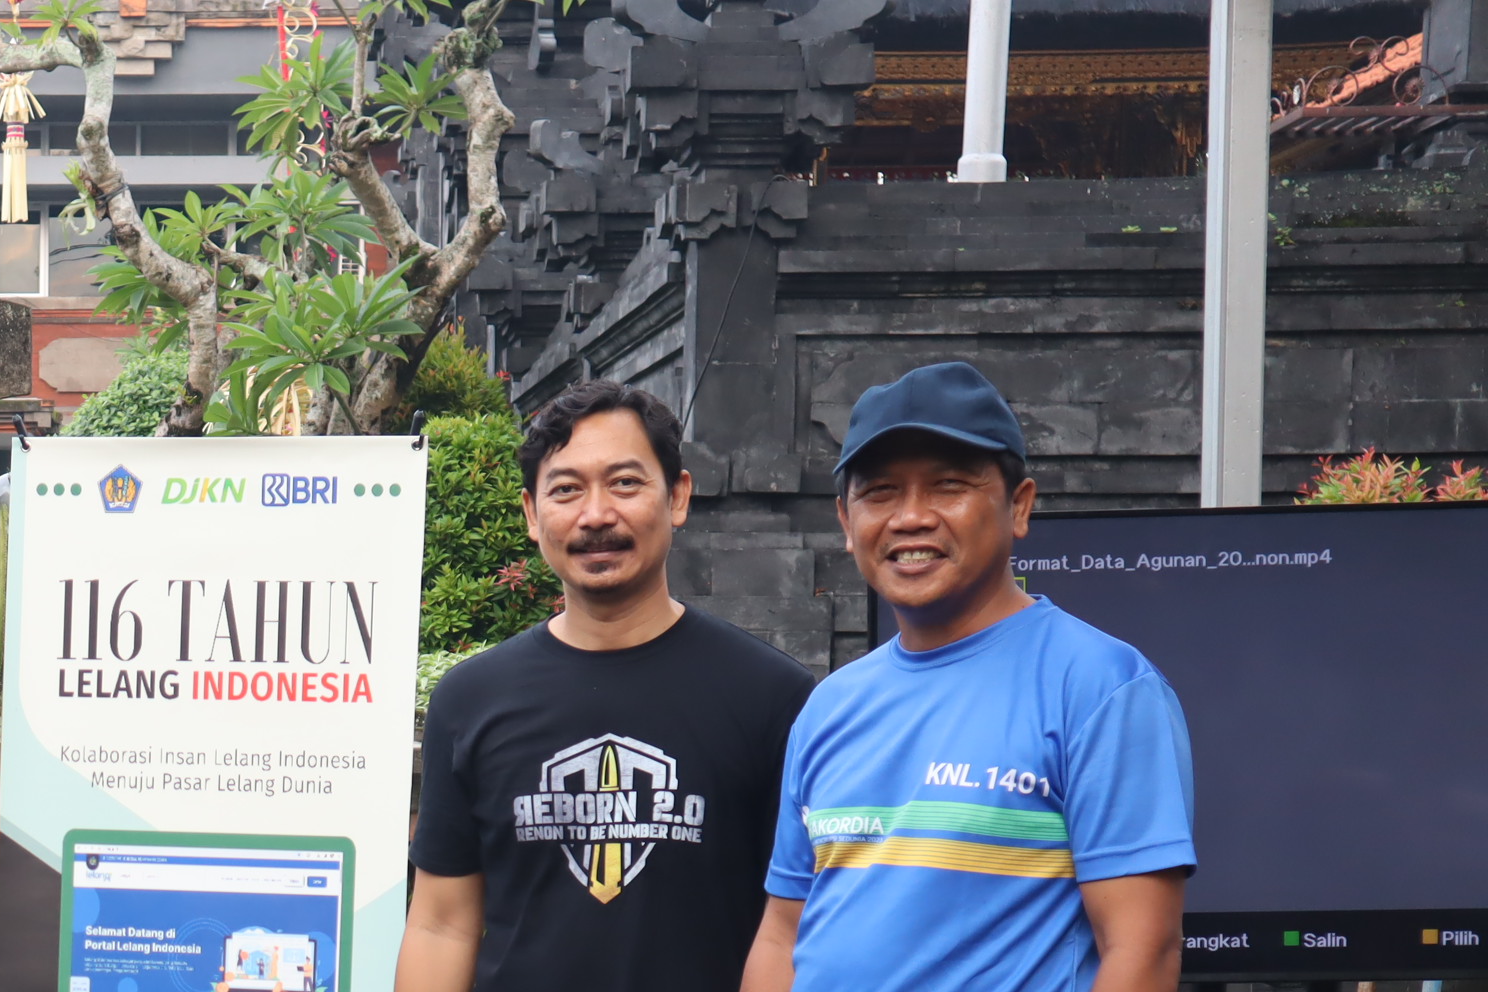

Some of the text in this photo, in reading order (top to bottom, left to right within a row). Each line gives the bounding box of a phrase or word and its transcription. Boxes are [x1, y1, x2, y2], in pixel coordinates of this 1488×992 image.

[161, 478, 246, 505] DJKN
[293, 476, 338, 504] BRI
[57, 579, 379, 664] 116 TAHUN
[59, 669, 373, 703] LELANG INDONESIA
[60, 745, 366, 771] Kolaborasi Insan Lelang Indonesia
[90, 772, 333, 797] Menuju Pasar Lelang Dunia
[925, 762, 980, 788] KNL.
[652, 791, 705, 826] 2.0
[516, 824, 702, 843] RENON TO BE NUMBER ONE
[810, 816, 884, 836] AKORDIA
[86, 926, 176, 940] Selamat Datang di
[1181, 933, 1250, 951] angkat
[1304, 932, 1347, 948] Salin
[1442, 930, 1479, 946] Pilih
[85, 939, 201, 954] Portal Lelang Indonesia
